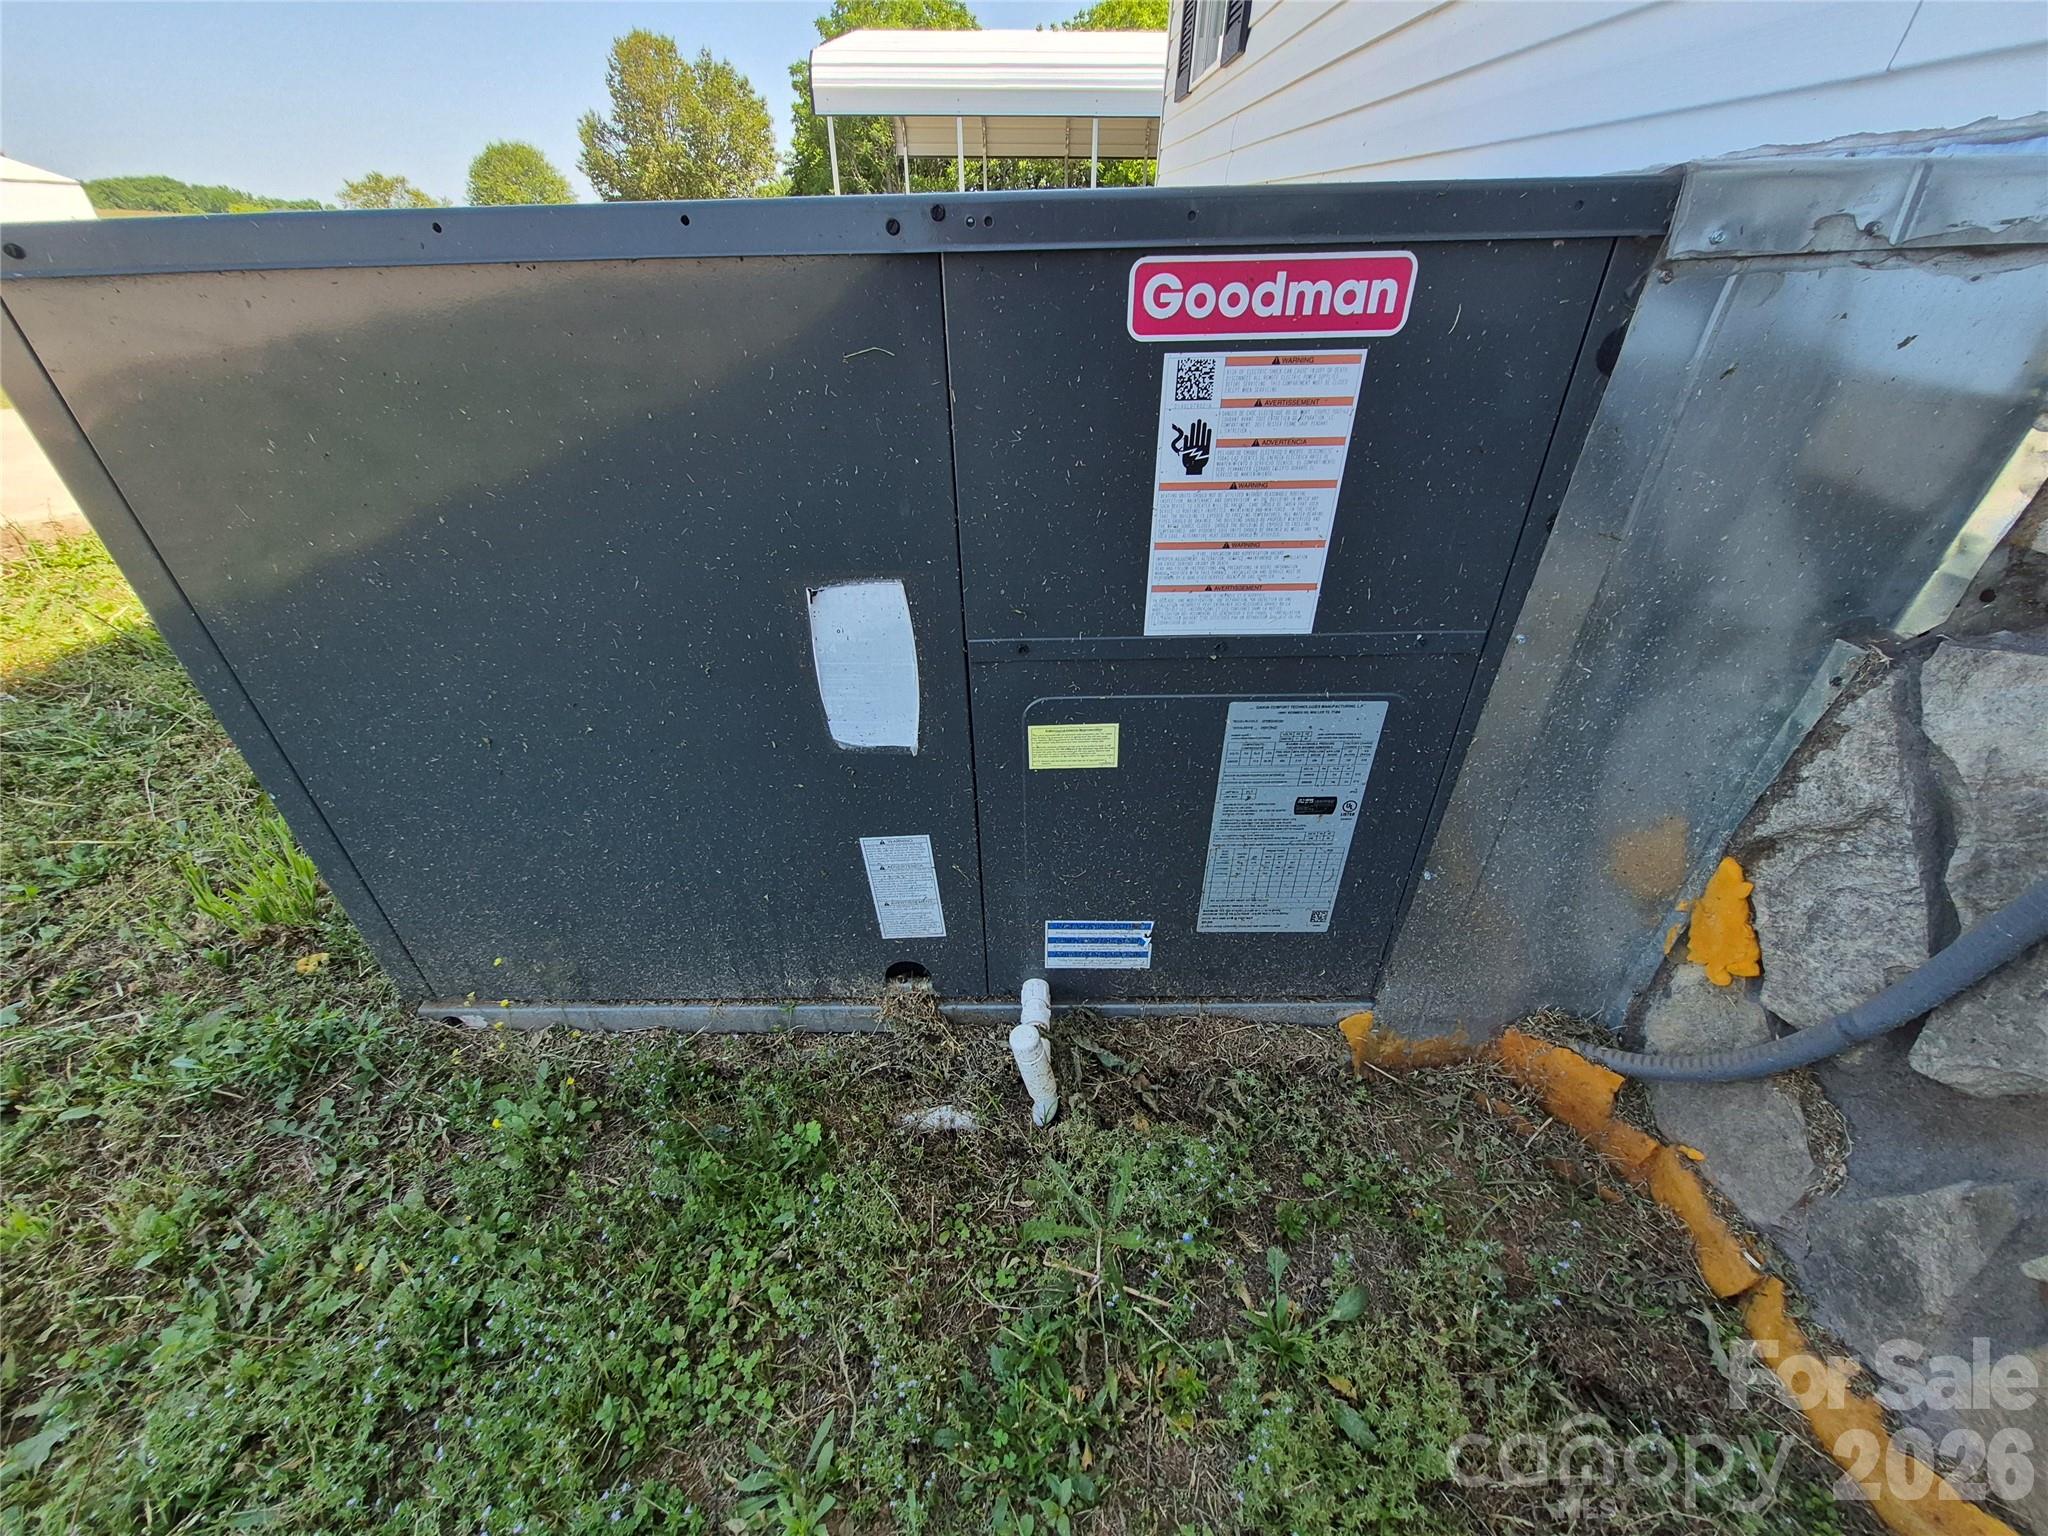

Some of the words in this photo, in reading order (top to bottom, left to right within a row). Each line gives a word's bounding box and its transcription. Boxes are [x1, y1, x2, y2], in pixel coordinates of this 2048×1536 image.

[1142, 271, 1399, 319] Goodman
[1264, 399, 1321, 407] AVERTISSEMENT
[1261, 438, 1307, 446] ADVERTENCIA
